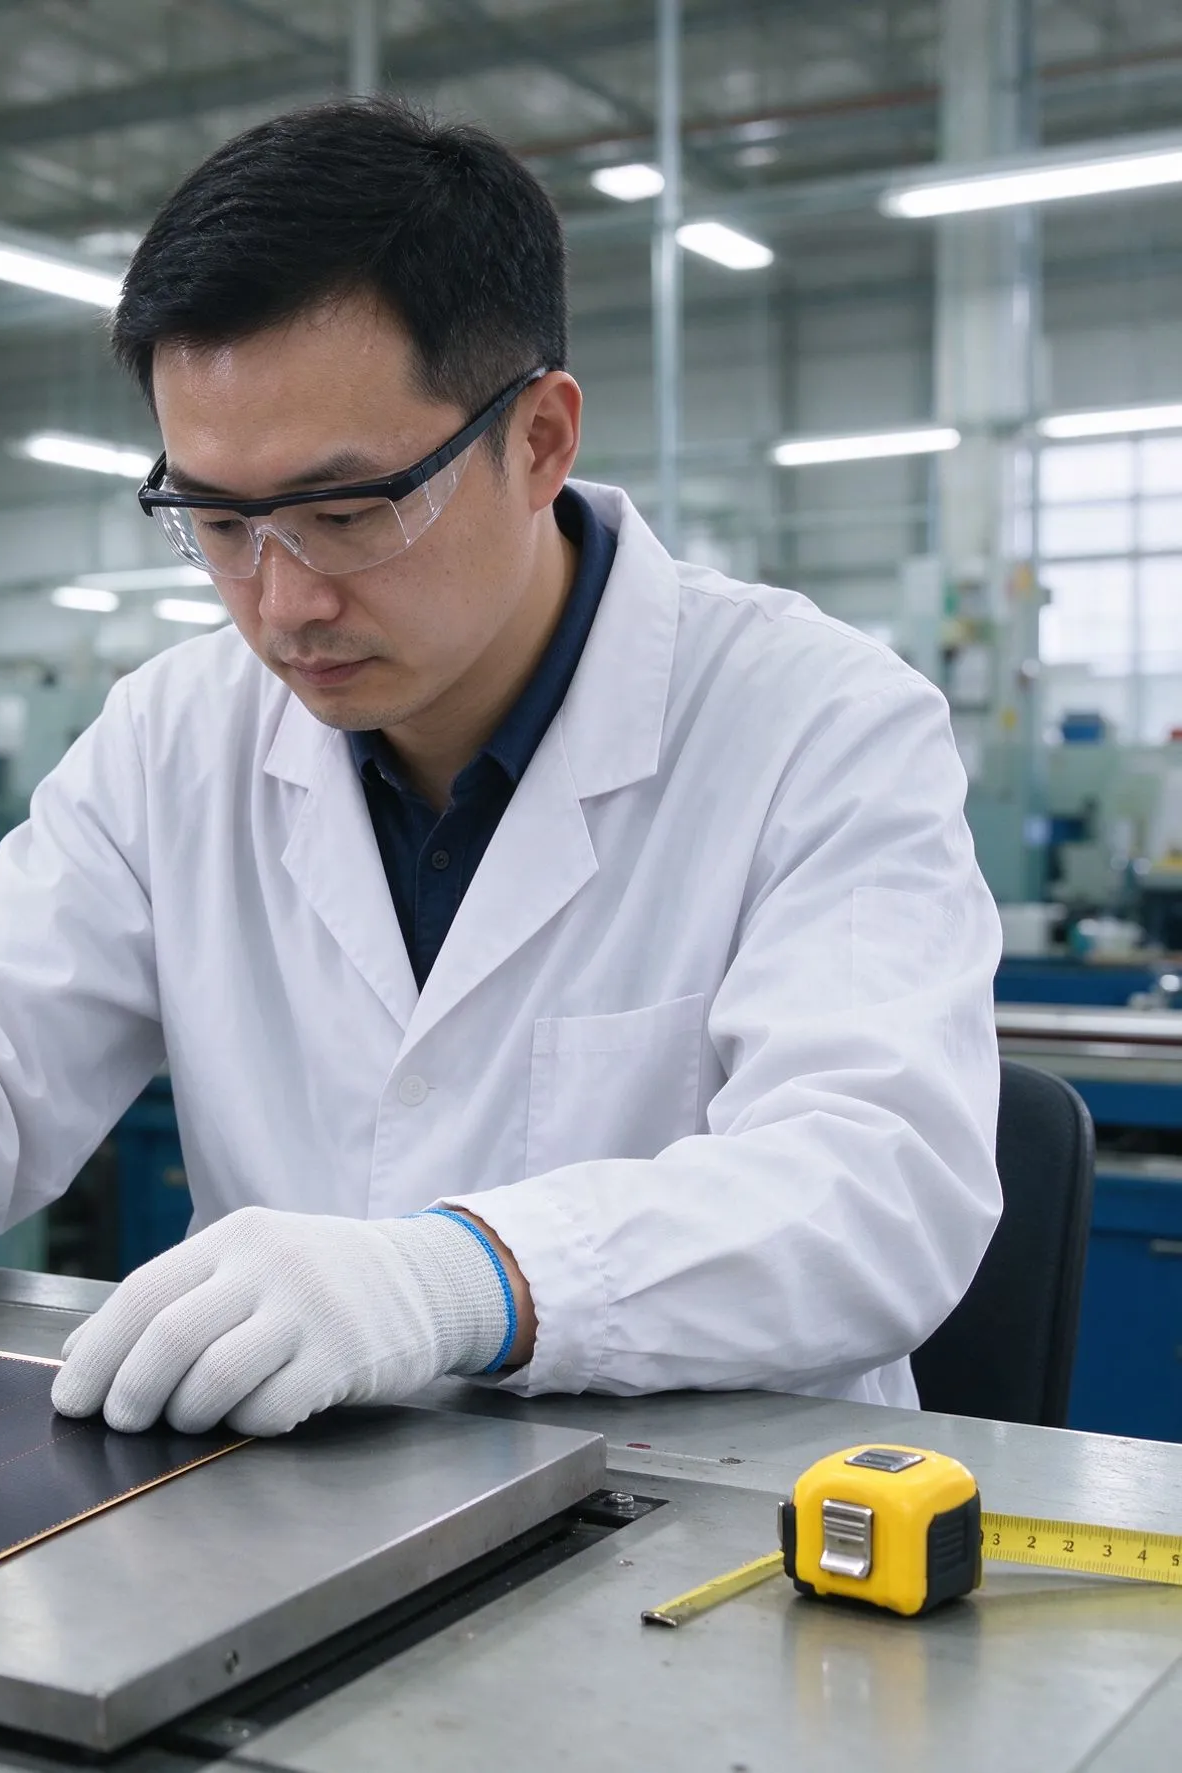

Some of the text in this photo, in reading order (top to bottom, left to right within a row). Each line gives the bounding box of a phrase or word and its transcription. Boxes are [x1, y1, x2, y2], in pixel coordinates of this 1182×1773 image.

[992, 1533, 1000, 1546] 3
[1027, 1536, 1037, 1549] 2
[1102, 1544, 1112, 1557] 3
[1137, 1549, 1147, 1561] 4
